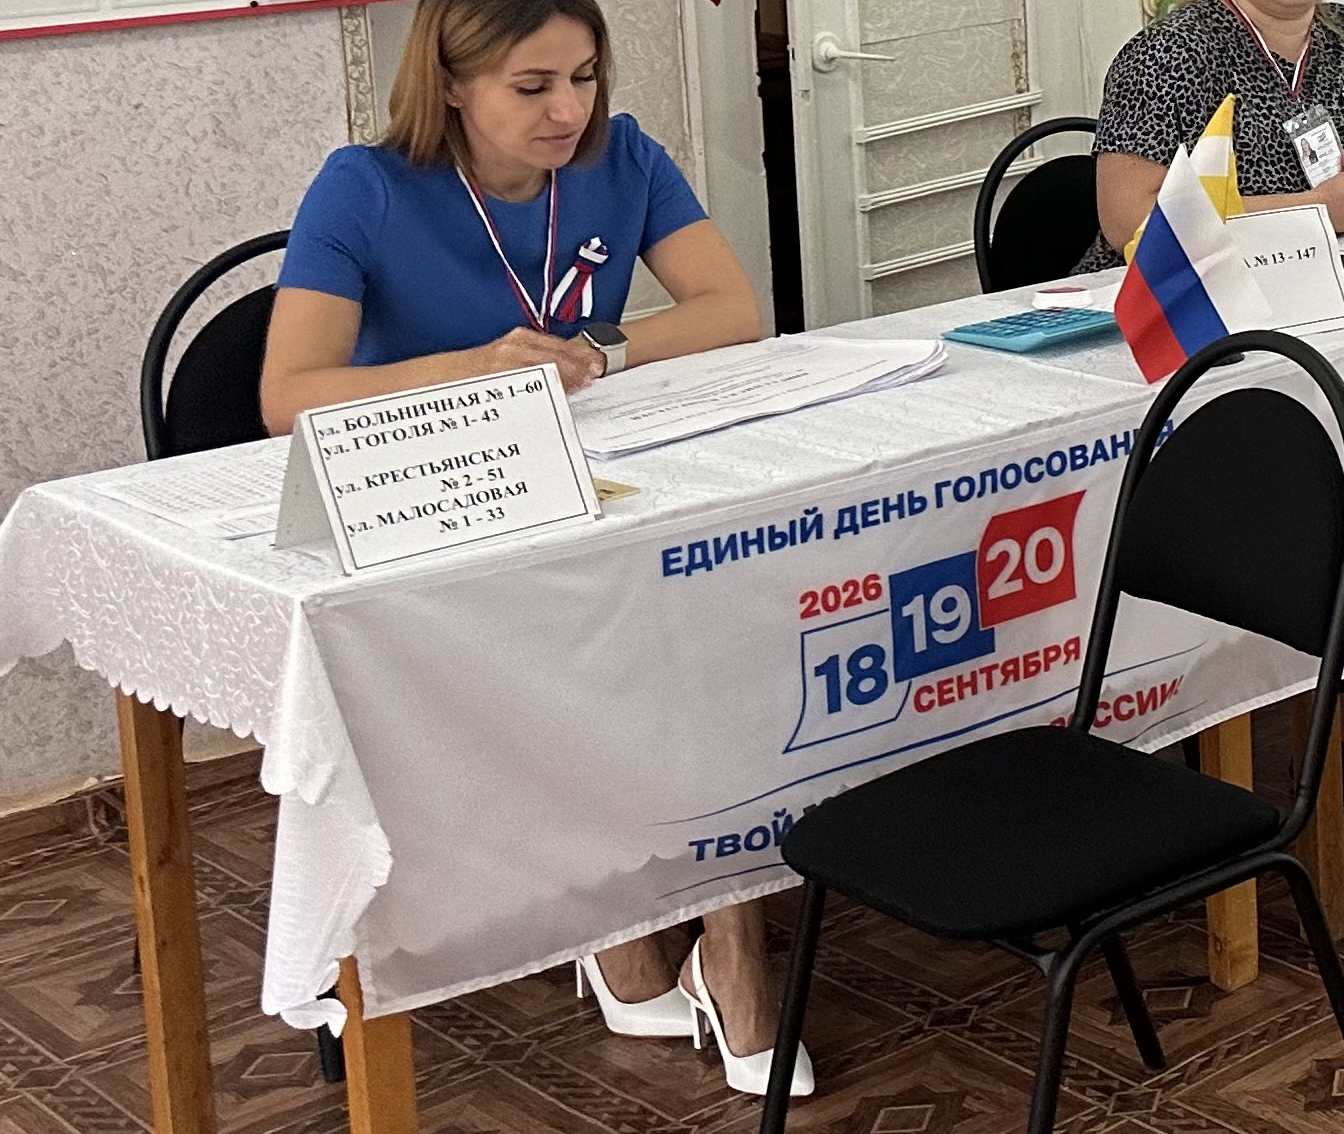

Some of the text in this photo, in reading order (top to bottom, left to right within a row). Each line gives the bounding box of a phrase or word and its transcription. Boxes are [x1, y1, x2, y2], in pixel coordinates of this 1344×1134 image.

[1271, 251, 1285, 264] 13
[1296, 246, 1317, 260] 147
[317, 423, 341, 440] ул.
[343, 392, 481, 433] БОЛЬНИЧНАЯ
[486, 387, 504, 403] №
[322, 442, 350, 460] ул.
[352, 422, 434, 451] ГОГОЛЯ
[439, 417, 458, 434] №
[481, 407, 501, 424] 43
[334, 443, 522, 498] ул. КРЕСТЬЯНСКАЯ
[440, 477, 459, 493] №
[464, 473, 473, 488] 2
[487, 467, 506, 482] 51
[346, 480, 529, 537] ул. МАЛОСАДОВАЯ
[439, 517, 459, 534] №
[464, 513, 472, 528] 1
[487, 506, 506, 523] 33
[661, 507, 826, 578] ЕДИНЫЙ
[833, 489, 928, 541] ДЕНЬ
[799, 573, 883, 620] 2026
[813, 525, 1066, 716] 18 19 20
[912, 636, 1083, 714] СЕНТЯБРЯ
[1050, 674, 1184, 728] ССИИ!
